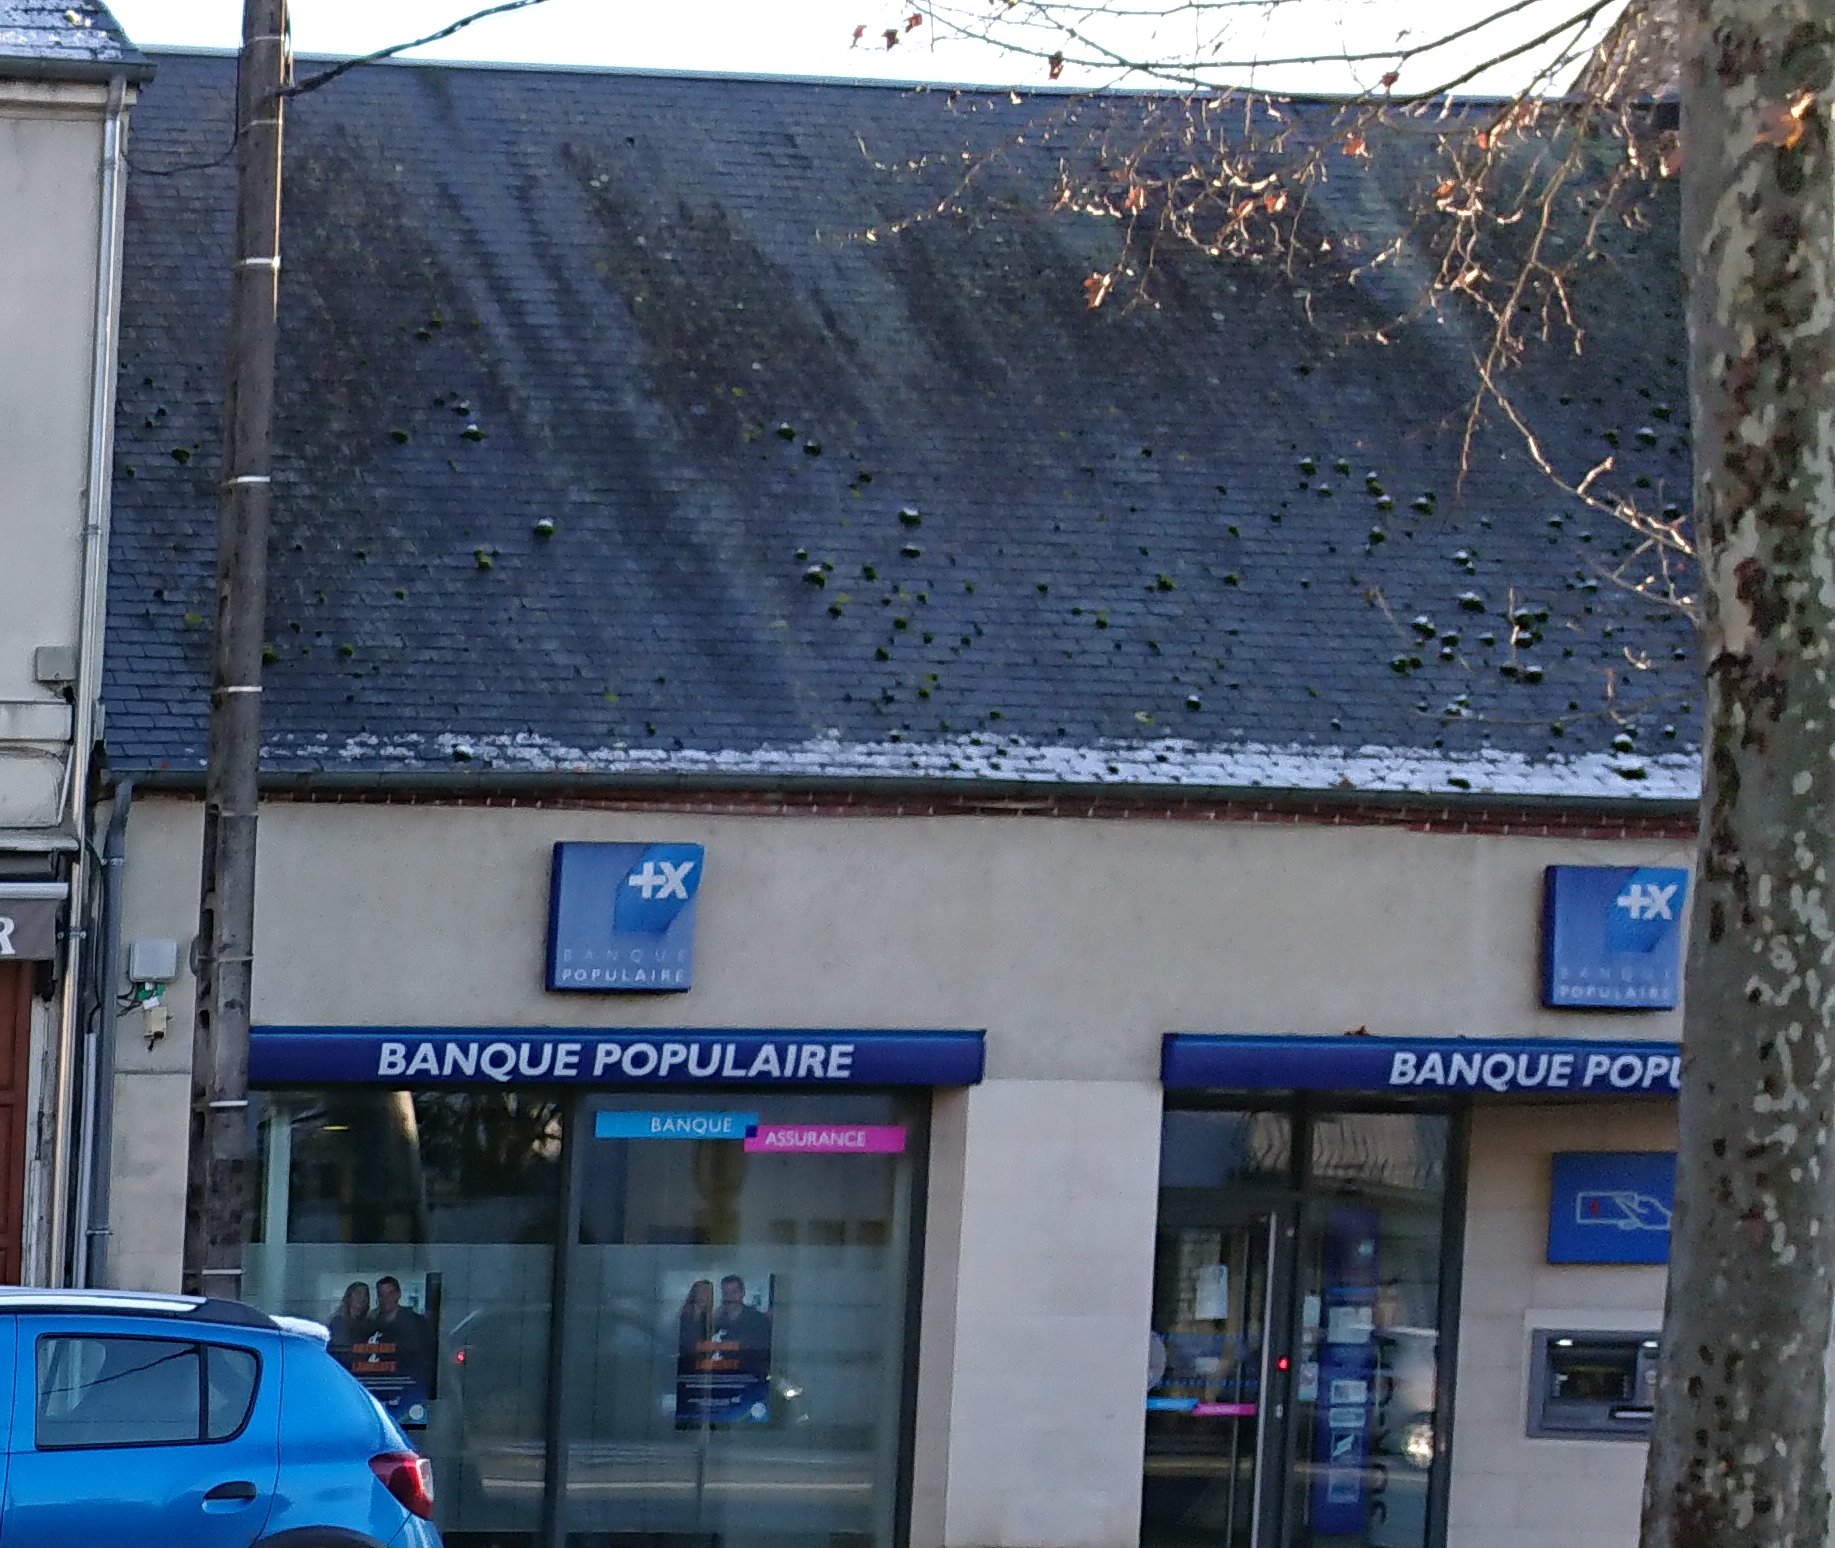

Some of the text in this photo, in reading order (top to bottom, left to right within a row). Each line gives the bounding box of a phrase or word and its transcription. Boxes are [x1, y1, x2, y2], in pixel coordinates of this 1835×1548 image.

[562, 968, 684, 982] POPULAIRE
[377, 1042, 856, 1083] BANQUE POPULAIRE
[1389, 1051, 1575, 1091] BANQUE
[650, 1117, 732, 1135] BANQUE
[764, 1130, 867, 1147] ASSURANCE
